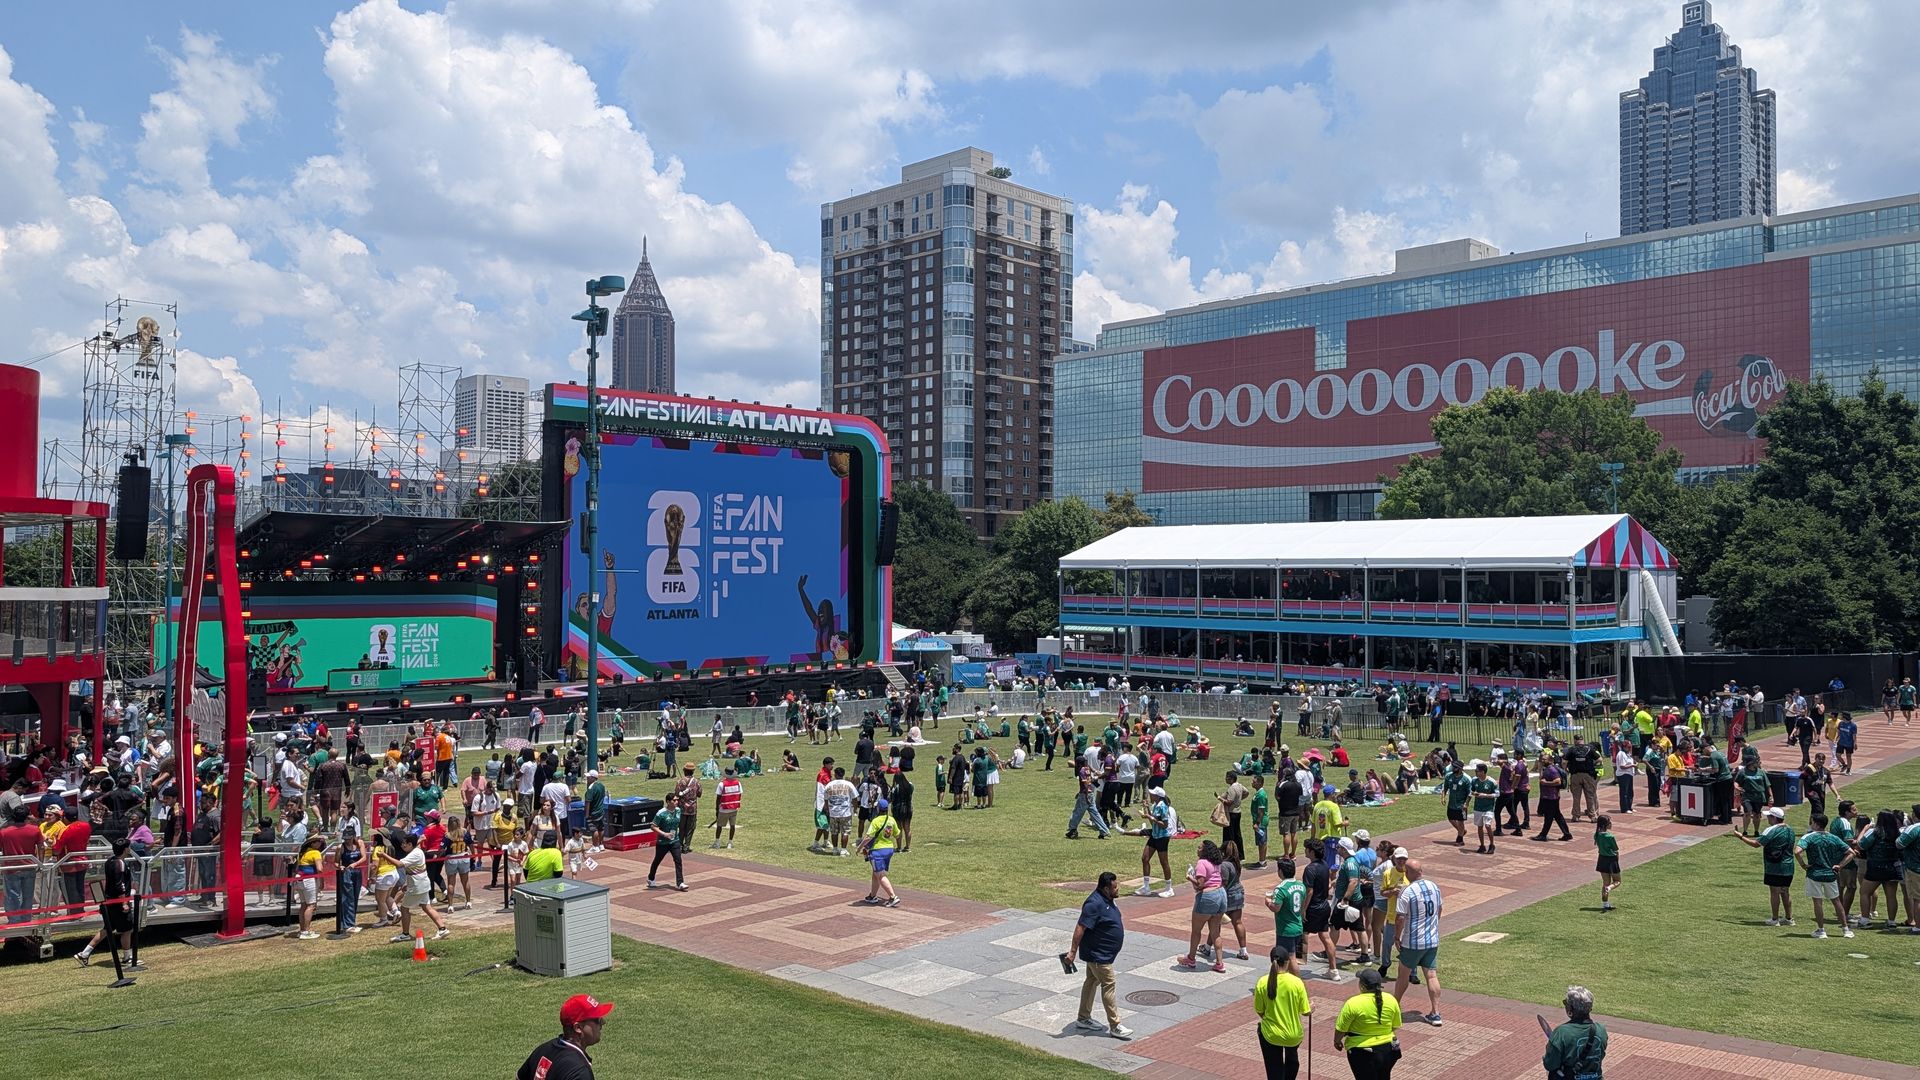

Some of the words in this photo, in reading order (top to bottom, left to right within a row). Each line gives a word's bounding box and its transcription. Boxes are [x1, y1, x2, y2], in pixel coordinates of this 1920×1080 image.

[133, 369, 160, 381] FIFA
[1695, 356, 1787, 430] Coca-Cola
[727, 409, 834, 436] ATLANTA
[713, 493, 724, 531] FIFA
[726, 493, 783, 532] FAN
[712, 536, 784, 574] FEST
[661, 581, 687, 594] FIFA
[646, 608, 700, 621] ATLANTA
[408, 623, 439, 638] FAN
[401, 638, 440, 653] FEST
[1292, 891, 1302, 913] 9
[1423, 899, 1435, 918] 10
